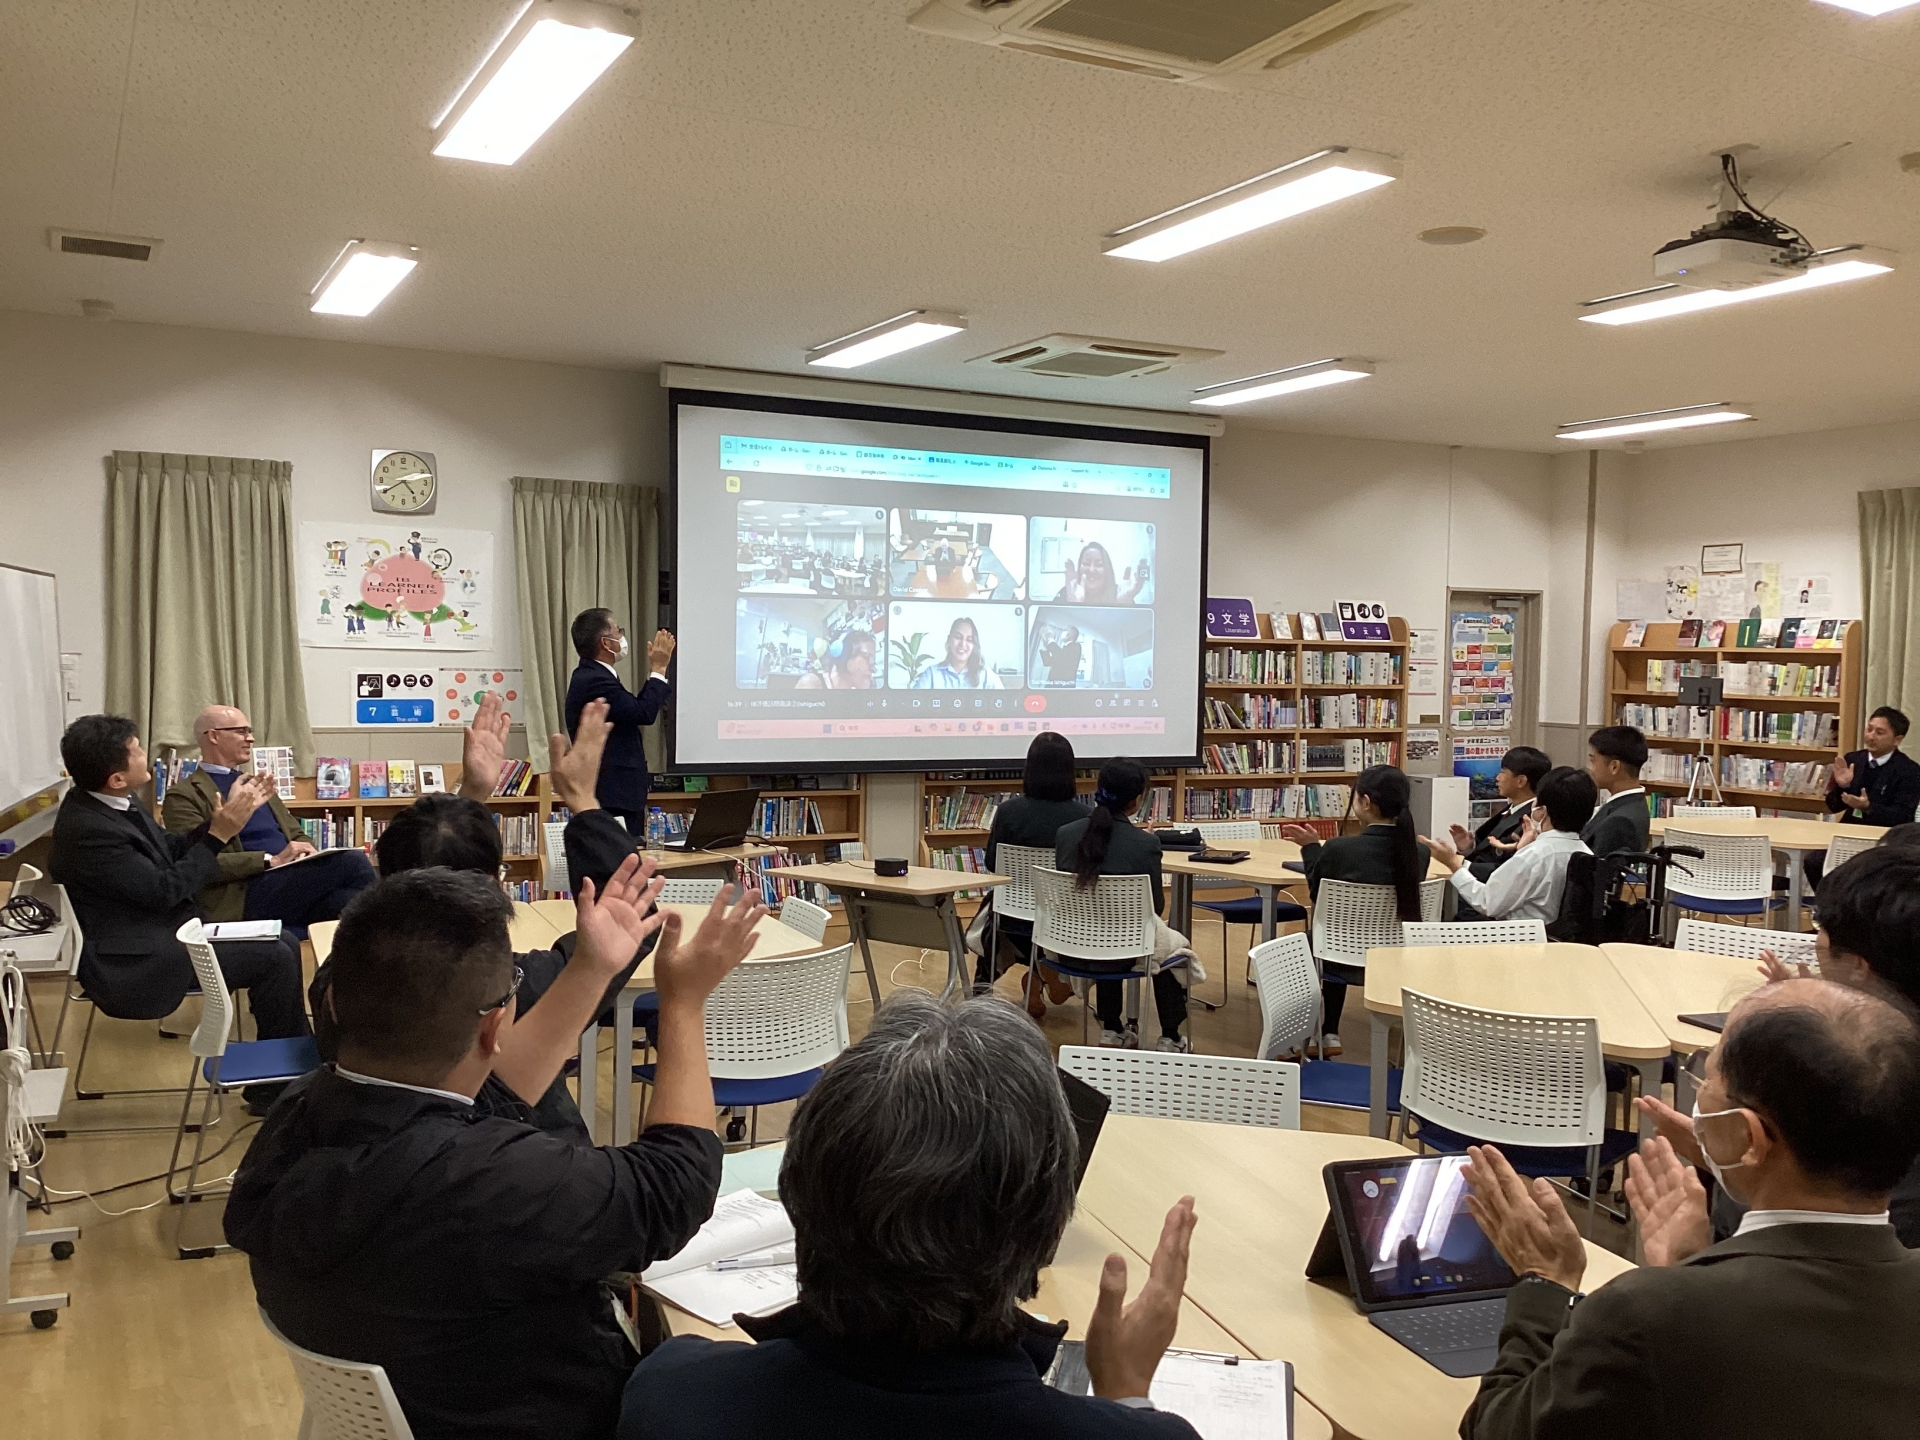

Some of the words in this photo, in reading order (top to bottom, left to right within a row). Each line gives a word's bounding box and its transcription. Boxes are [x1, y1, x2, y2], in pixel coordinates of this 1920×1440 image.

[1207, 612, 1215, 624] 9
[1222, 612, 1250, 626] 文学
[369, 707, 376, 716] 7
